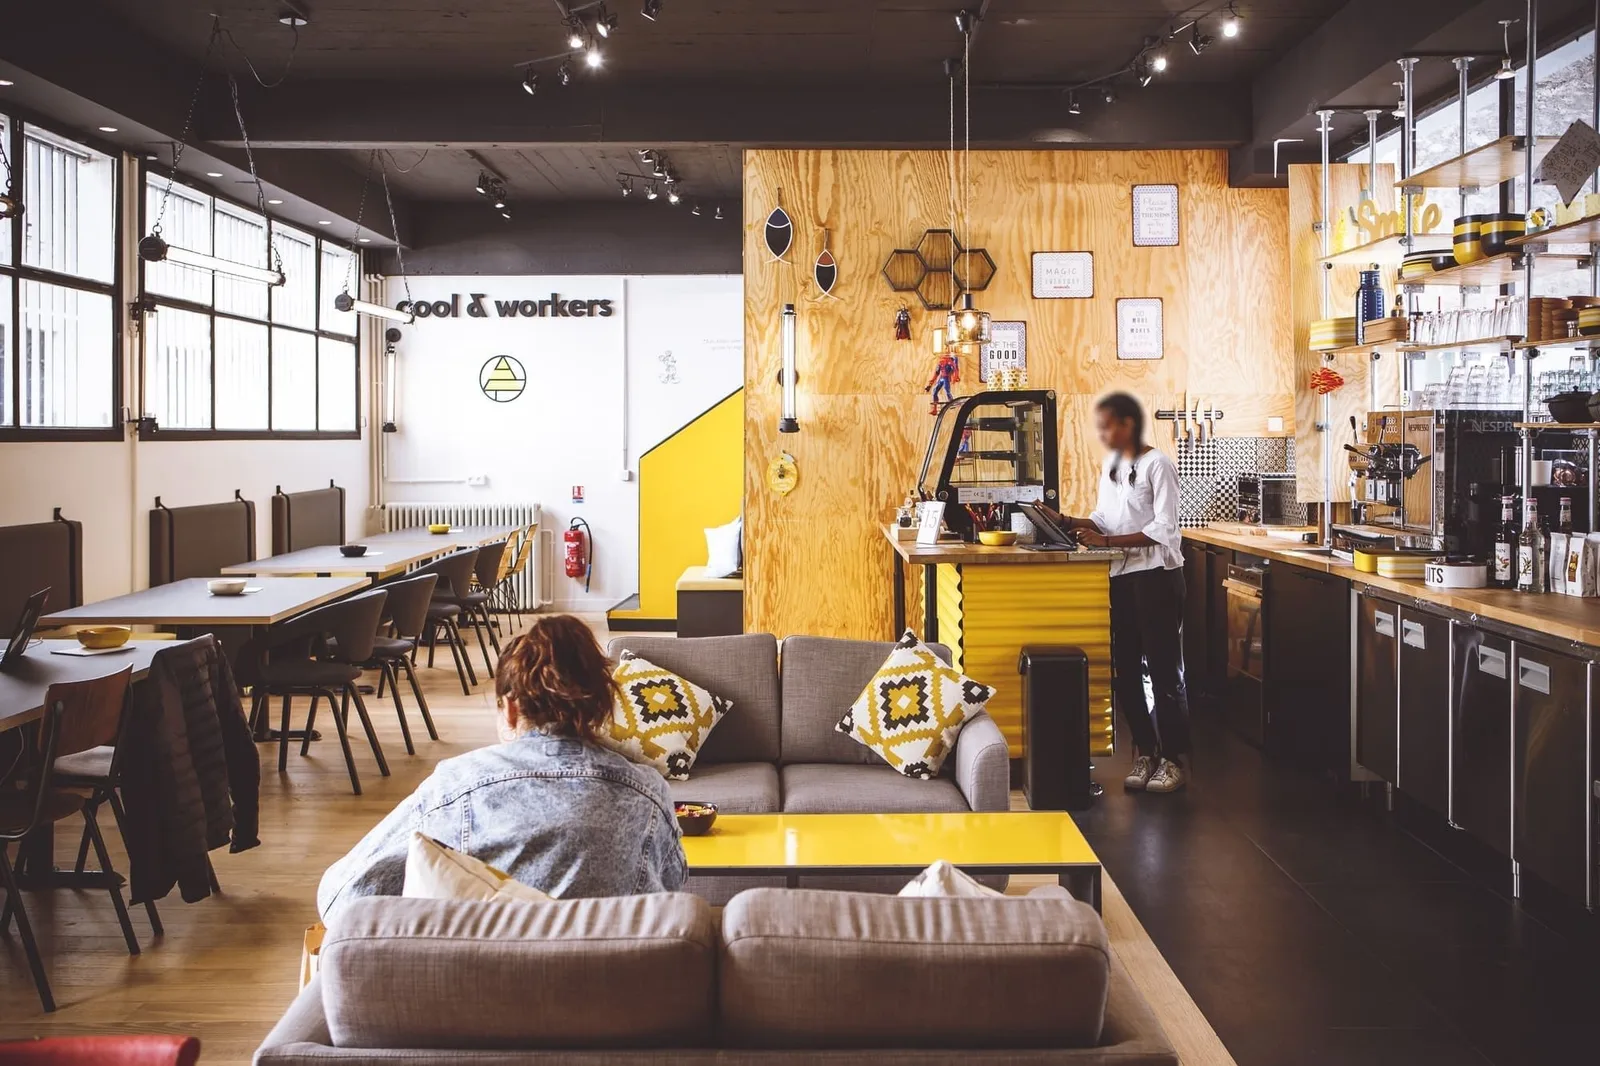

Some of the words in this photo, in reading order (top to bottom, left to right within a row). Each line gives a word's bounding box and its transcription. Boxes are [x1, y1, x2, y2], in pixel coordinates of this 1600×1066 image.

[1358, 188, 1440, 240] Sme
[467, 294, 488, 317] &
[494, 293, 612, 317] workers
[989, 350, 1017, 360] GOOD
[1003, 341, 1017, 349] THE
[924, 509, 940, 529] 15
